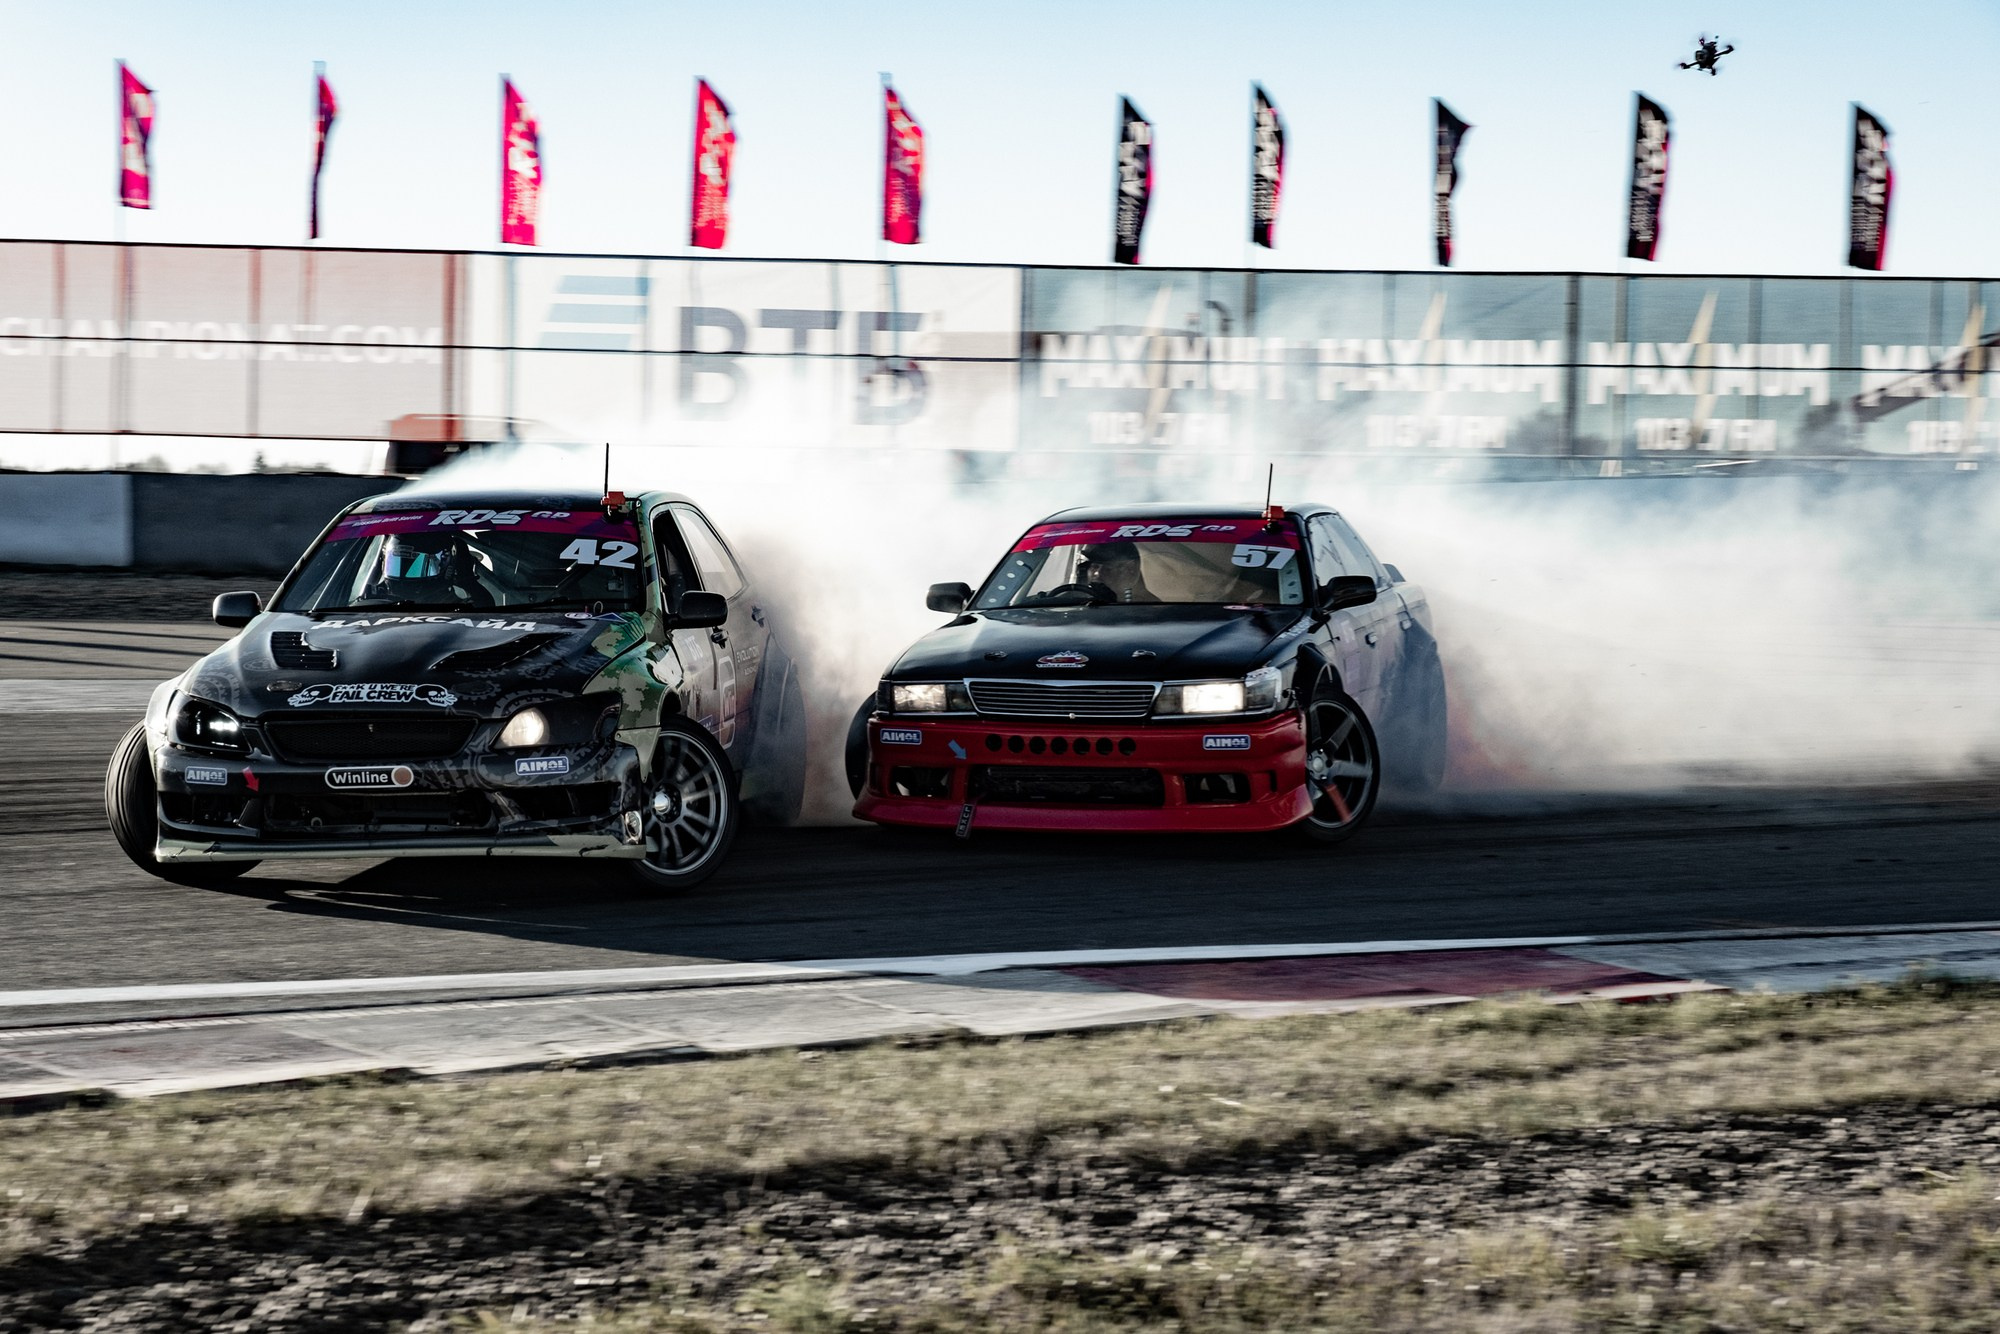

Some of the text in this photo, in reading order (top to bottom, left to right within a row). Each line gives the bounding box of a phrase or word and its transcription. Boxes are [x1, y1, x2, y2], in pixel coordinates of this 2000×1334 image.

[1587, 342, 1831, 406] MAXIMUM
[428, 510, 532, 525] RDS
[1110, 525, 1202, 538] RDS
[559, 538, 640, 570] 42
[1231, 543, 1296, 570] 57
[311, 615, 537, 632] ДАРКСАЙД
[331, 690, 415, 701] FAIL CREW
[1205, 738, 1249, 748] AIMOL
[519, 760, 566, 772] AIMOL
[186, 769, 225, 782] AIMOL
[333, 771, 389, 784] Winline
